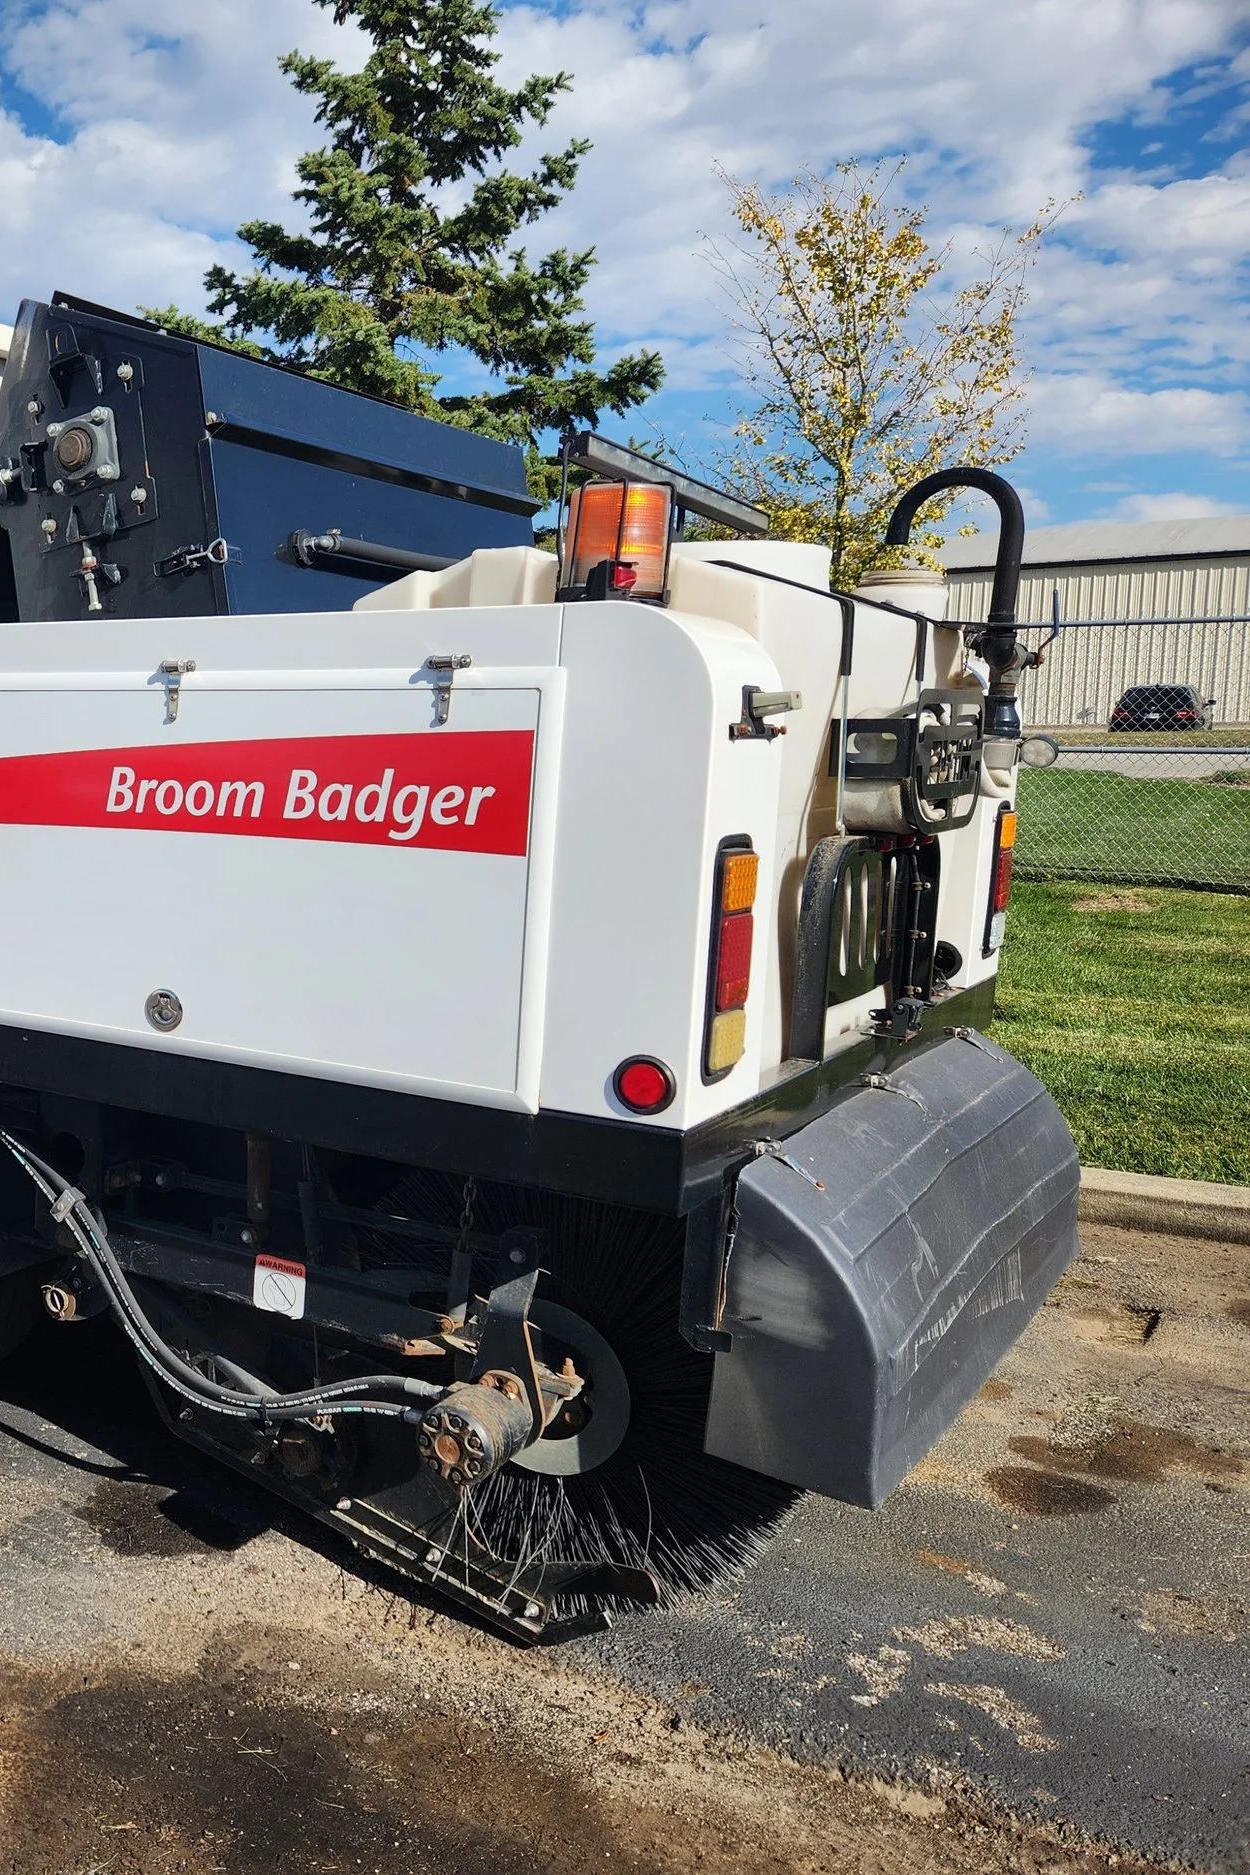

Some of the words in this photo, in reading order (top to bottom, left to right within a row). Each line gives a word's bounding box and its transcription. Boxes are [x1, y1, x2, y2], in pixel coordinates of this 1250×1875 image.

[106, 766, 266, 818] Broom
[282, 768, 497, 842] Badger
[264, 1260, 303, 1276] WARNING
